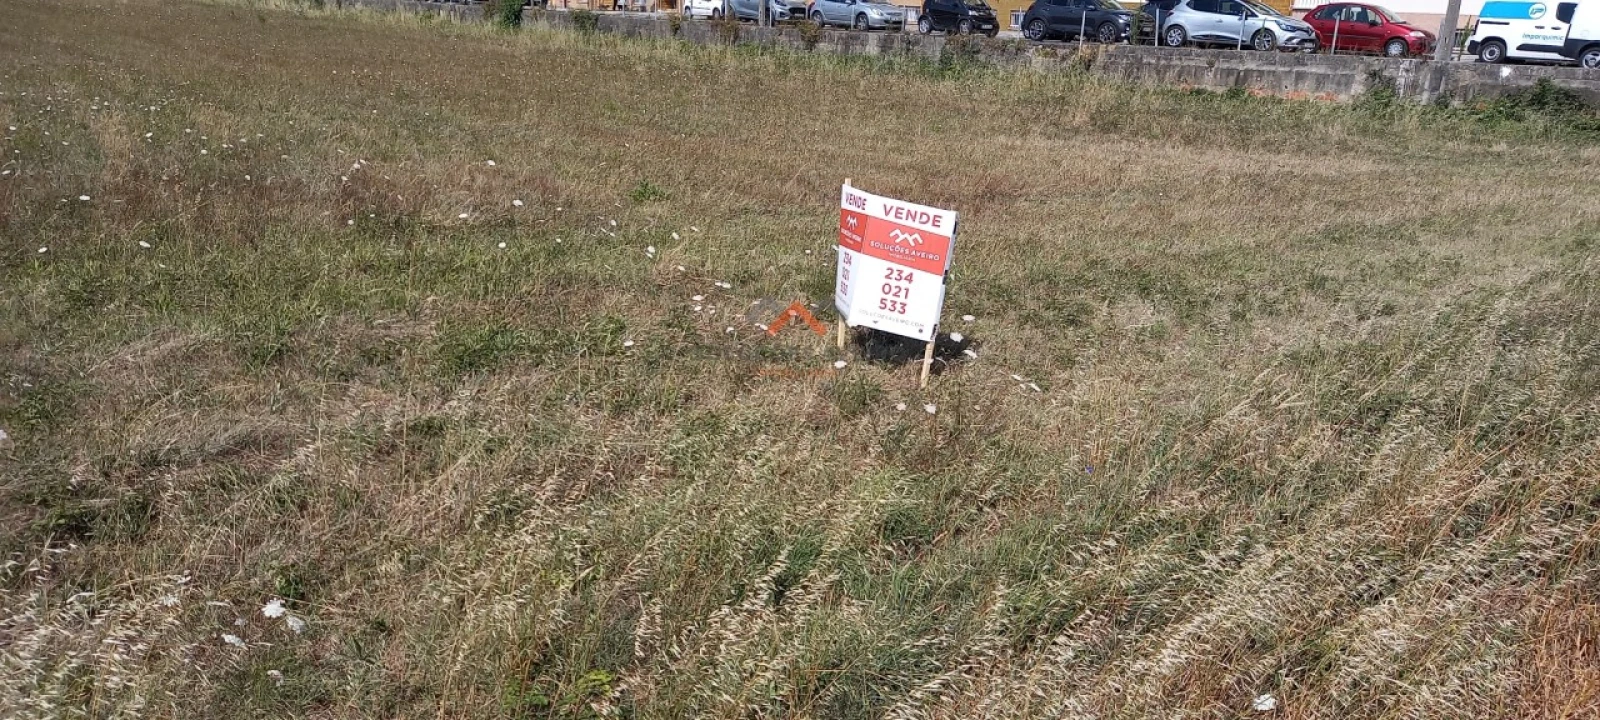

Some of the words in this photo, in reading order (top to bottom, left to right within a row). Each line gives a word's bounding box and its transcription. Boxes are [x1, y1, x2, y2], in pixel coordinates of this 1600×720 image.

[845, 192, 867, 211] VENDE
[883, 203, 943, 228] VENDE
[870, 240, 910, 256] SOLUÇÕES
[911, 247, 940, 261] AVEIRO
[884, 267, 914, 284] 234
[881, 283, 910, 299] 021
[878, 298, 908, 315] 533
